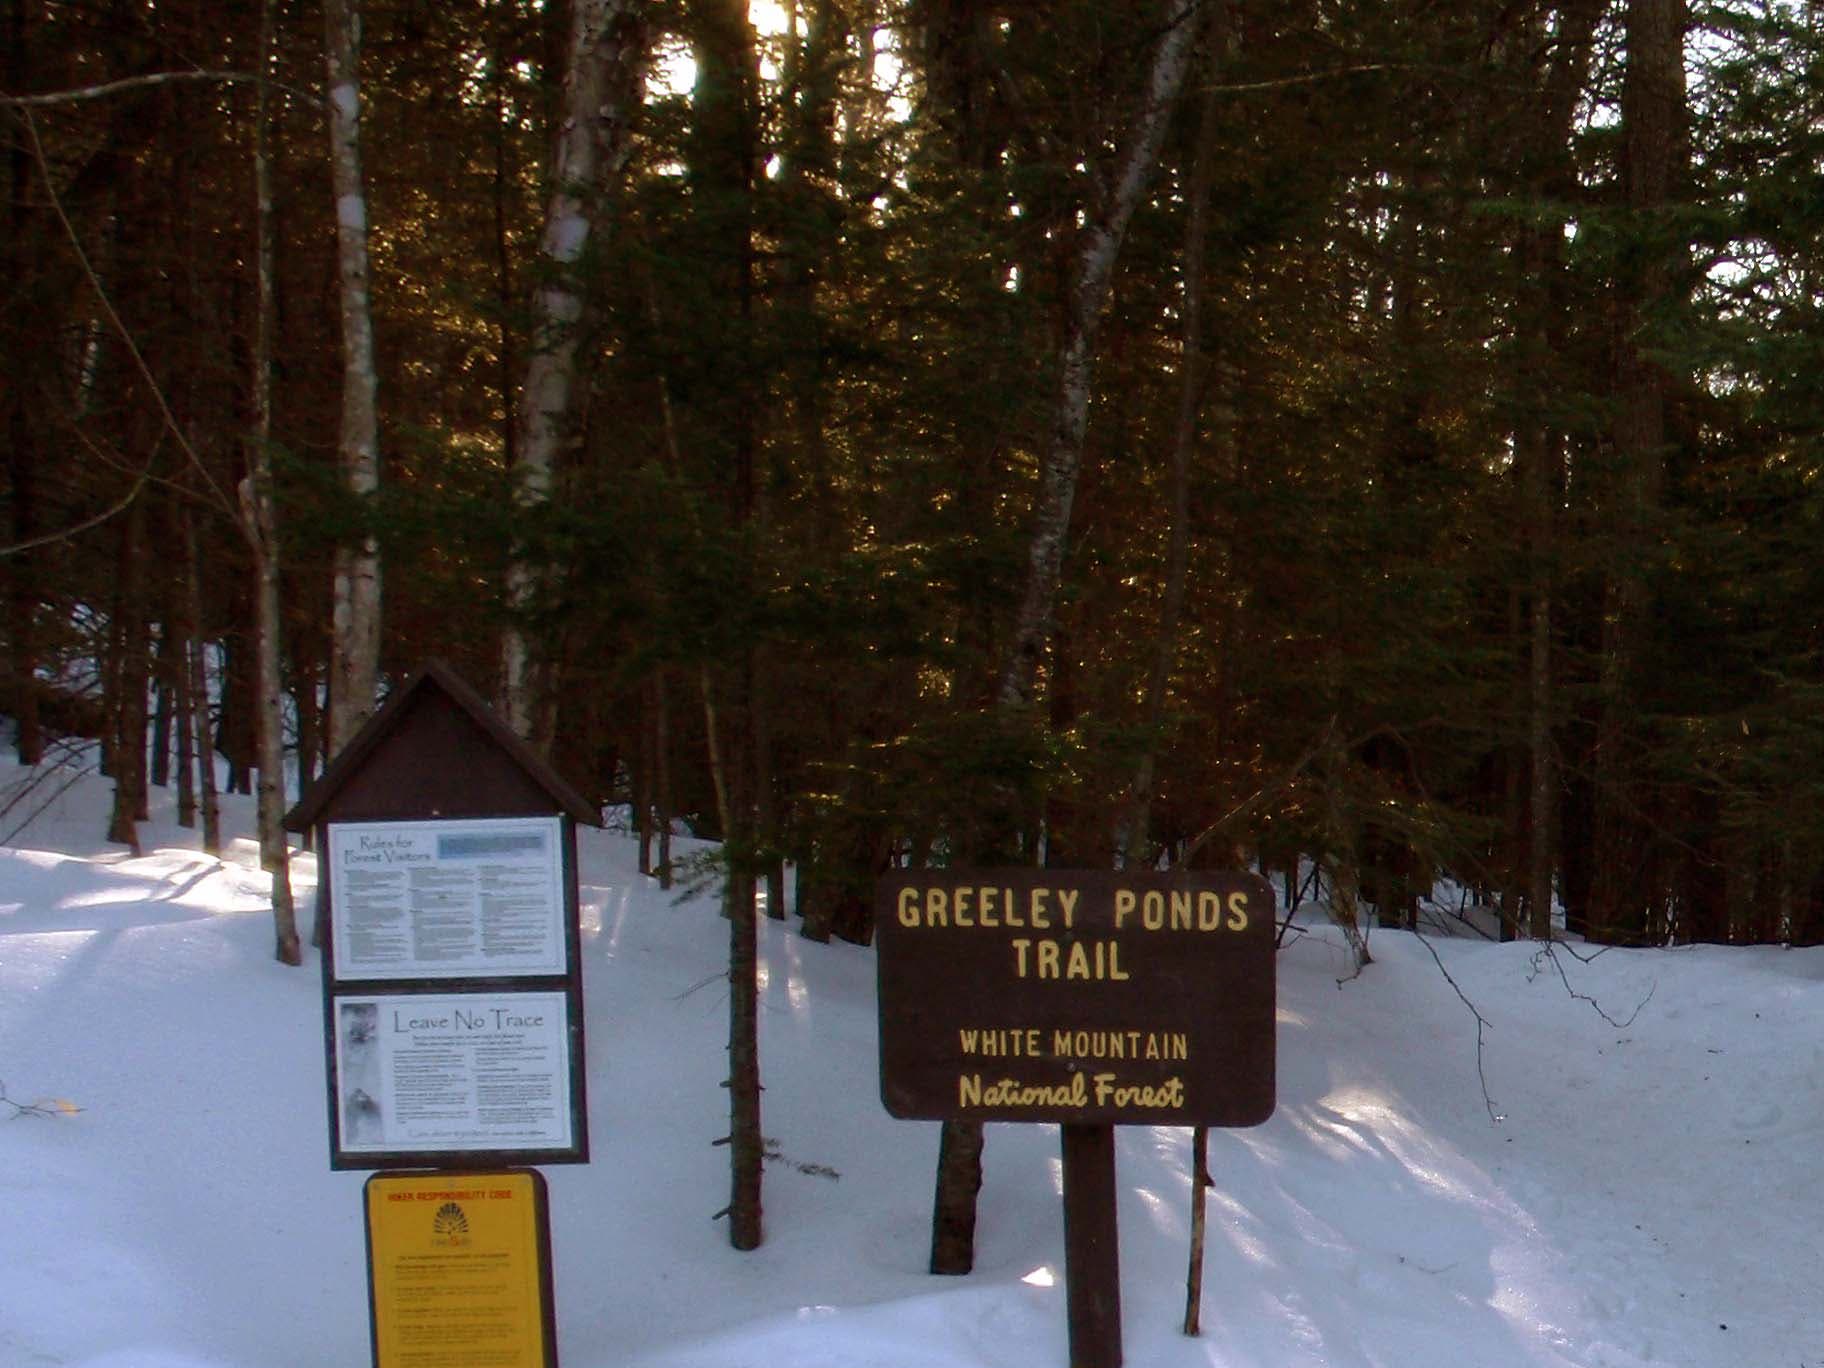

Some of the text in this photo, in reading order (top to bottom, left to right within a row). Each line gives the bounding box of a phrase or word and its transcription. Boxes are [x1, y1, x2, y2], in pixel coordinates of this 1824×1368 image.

[344, 849, 432, 865] Forest Visitors
[359, 832, 415, 850] Rules for
[898, 886, 1249, 932] GREELEY PONDS
[1012, 938, 1130, 981] TRAIL
[393, 1008, 545, 1033] Leave No Trace
[959, 1028, 1188, 1061] WHITE MOUNTAIN
[958, 1071, 1185, 1109] National Forest
